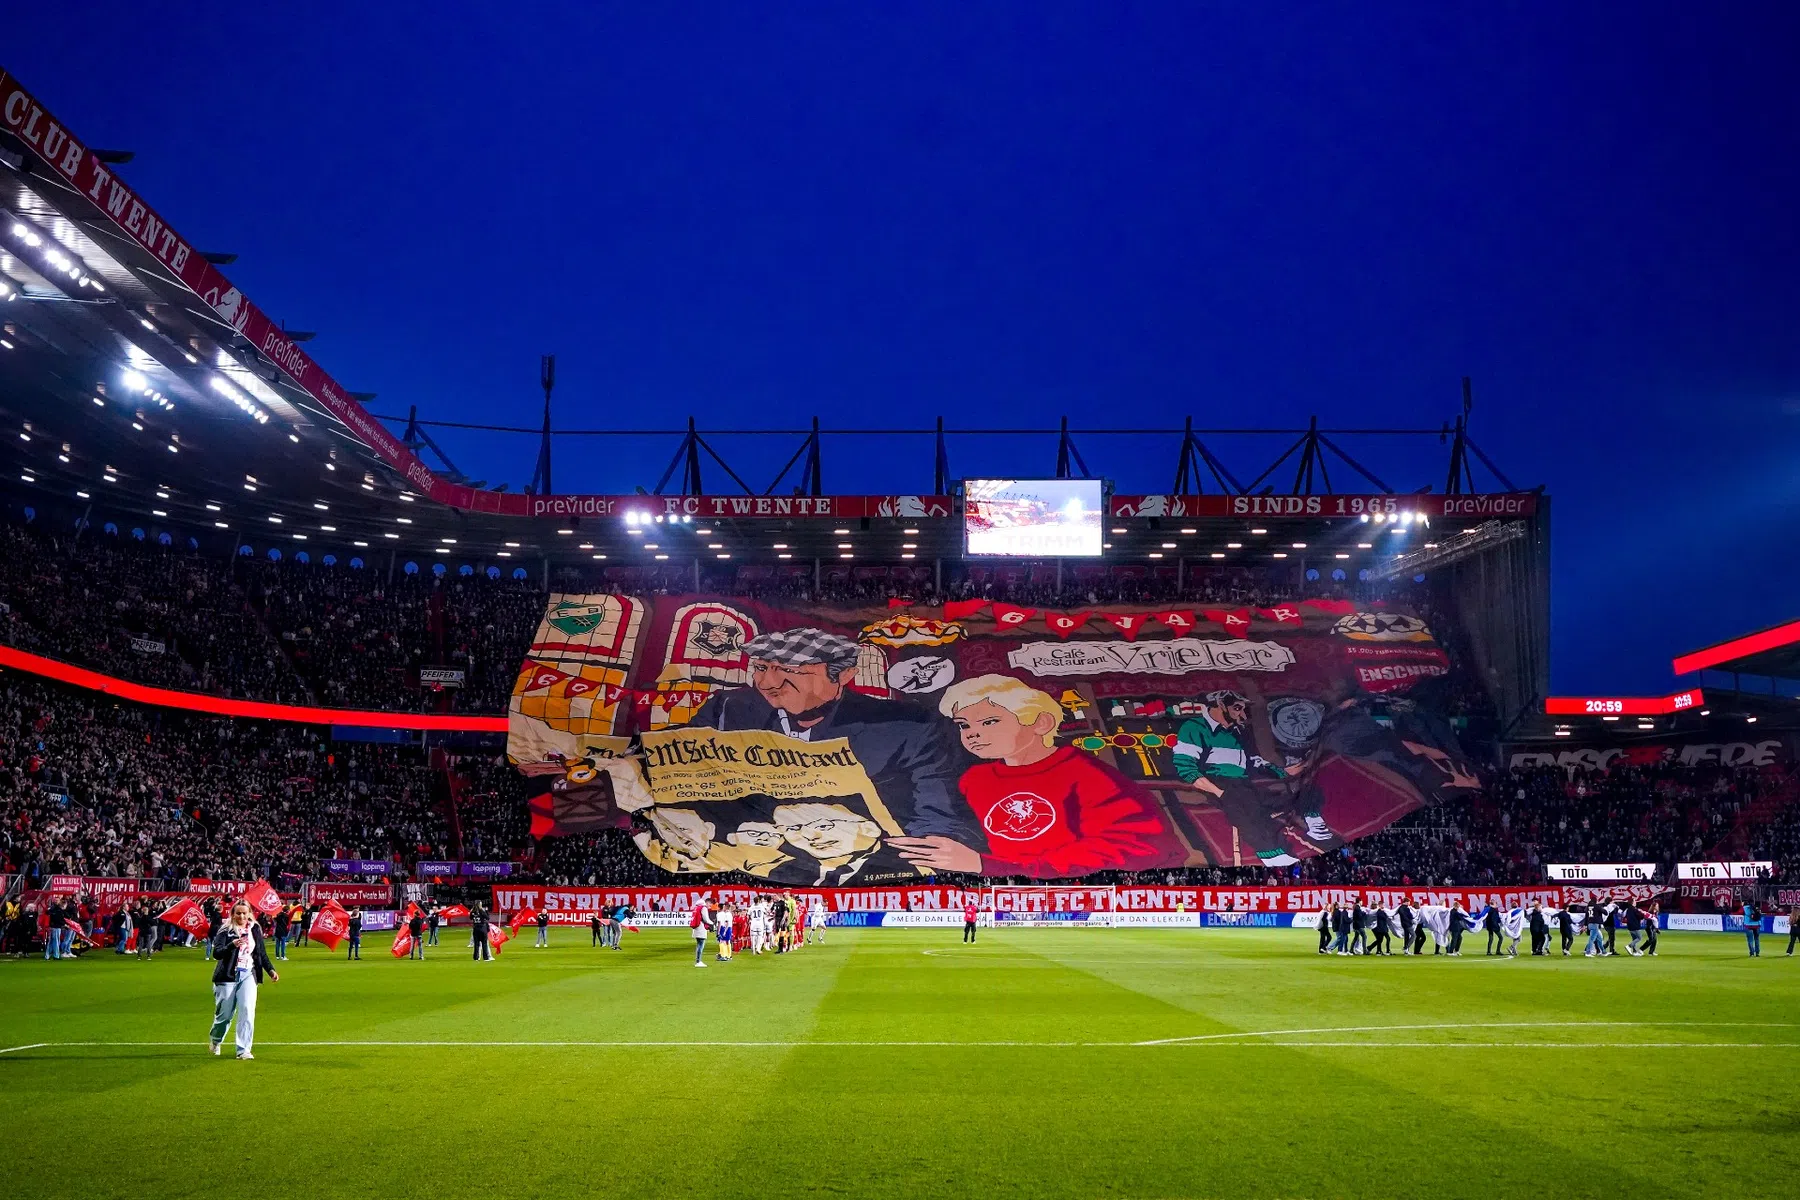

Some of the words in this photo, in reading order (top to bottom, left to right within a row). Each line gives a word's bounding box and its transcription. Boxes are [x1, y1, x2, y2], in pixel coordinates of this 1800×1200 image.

[5, 91, 83, 176] CLUB
[90, 165, 190, 272] TWENTE
[264, 333, 308, 378] previder
[407, 460, 435, 494] previder
[535, 497, 615, 516] previder
[664, 498, 699, 515] FC
[711, 498, 831, 515] TWENTE
[1234, 496, 1322, 514] SINDS
[1336, 498, 1398, 514] 1965
[1444, 496, 1524, 515] previder
[1051, 647, 1085, 660] Café
[1095, 643, 1274, 671] Vrieler
[1033, 655, 1108, 669] Restaurant
[421, 670, 454, 678] PFEIFER
[1586, 701, 1622, 712] 20:59
[1674, 694, 1691, 708] 20:59
[744, 745, 859, 769] Courant
[361, 862, 385, 873] looping
[424, 864, 451, 873] looping
[473, 864, 501, 874] looping
[1561, 867, 1588, 879] TOTO
[1615, 867, 1642, 879] TOTO
[1690, 867, 1716, 878] TOTO
[1741, 866, 1762, 877] TOTO
[874, 873, 896, 881] APRIL
[359, 890, 378, 900] Twente
[497, 891, 538, 910] UIT
[636, 891, 713, 912] KWAM
[835, 892, 903, 911] VUUR
[908, 890, 941, 911] EN
[1055, 892, 1084, 911] FC
[1090, 890, 1197, 911] TWENTE
[1202, 891, 1281, 911] LEEFT
[1287, 890, 1360, 911] SINDS
[1366, 891, 1406, 910] DIE
[1412, 892, 1464, 909] ENE
[1468, 891, 1560, 912] NACHT!
[634, 912, 652, 921] enny
[653, 911, 686, 919] Hendriks
[753, 910, 762, 919] 10
[1207, 913, 1278, 926] ELEKTRAMAT
